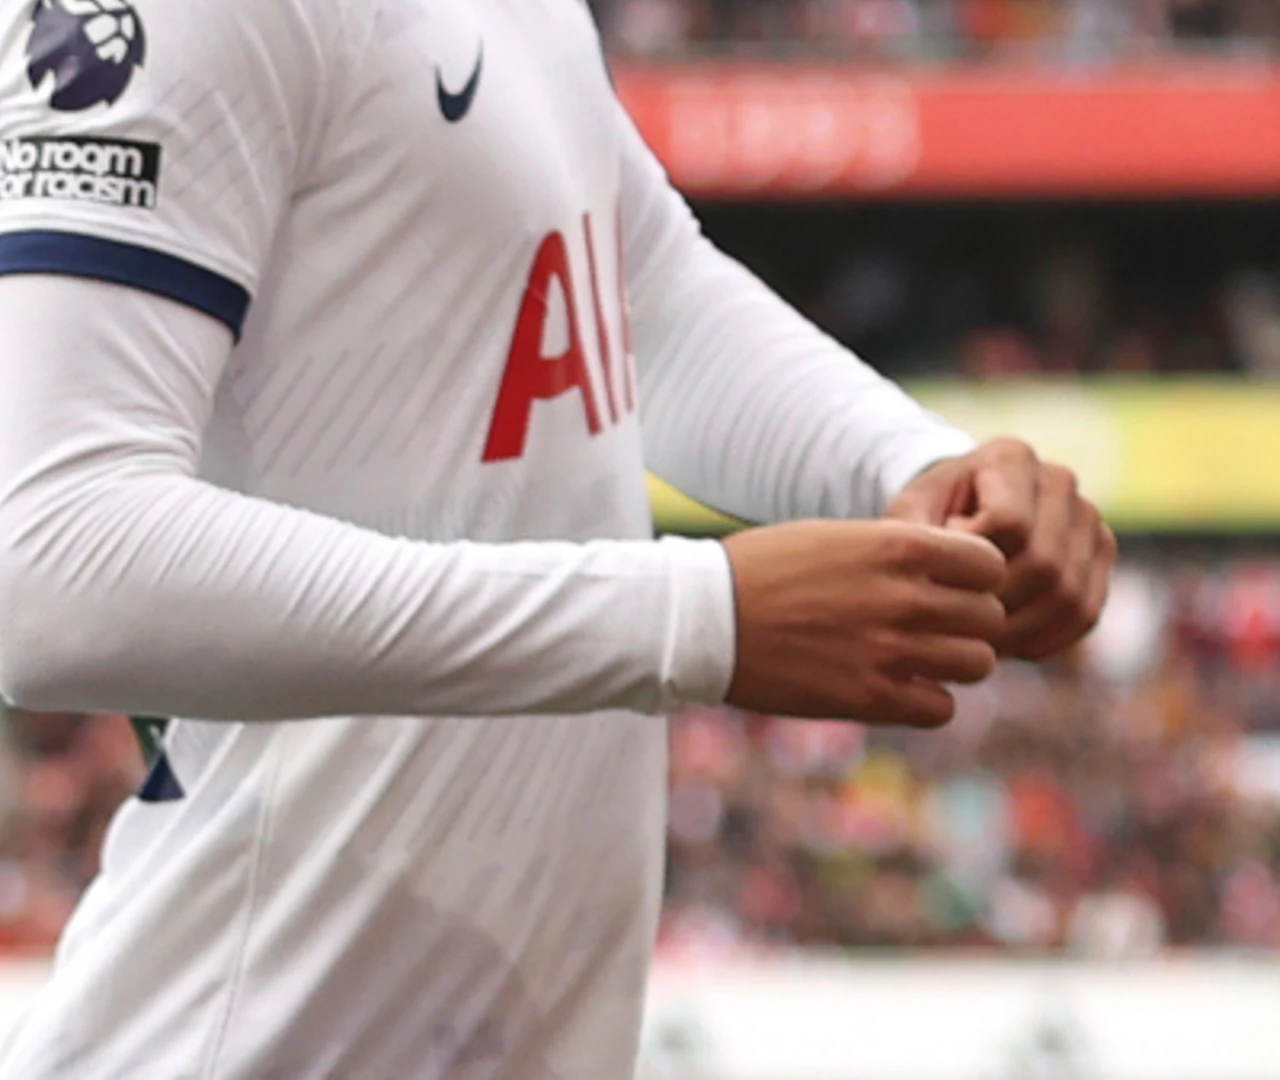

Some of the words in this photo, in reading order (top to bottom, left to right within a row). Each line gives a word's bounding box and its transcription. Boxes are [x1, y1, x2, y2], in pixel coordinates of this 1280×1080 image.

[0, 138, 37, 172] No
[42, 140, 143, 177] room
[34, 172, 156, 209] racism
